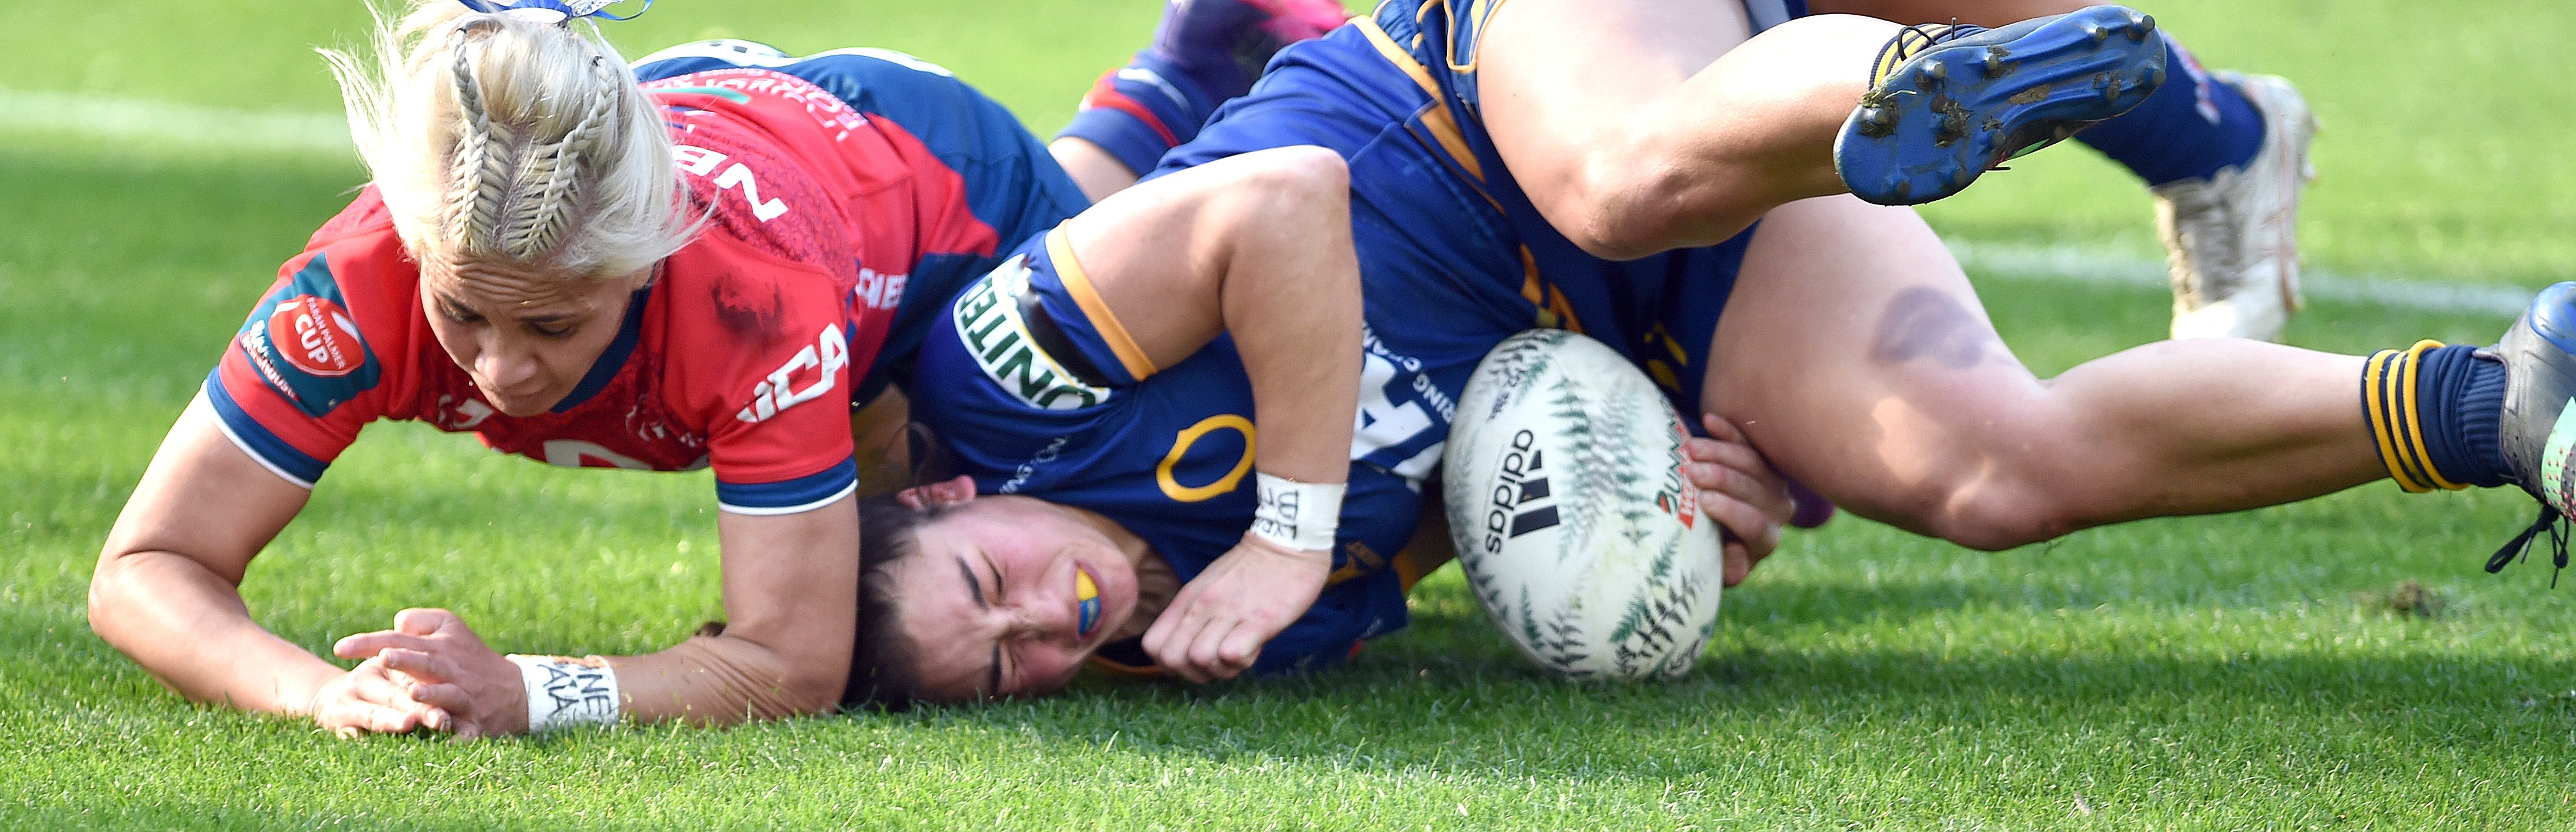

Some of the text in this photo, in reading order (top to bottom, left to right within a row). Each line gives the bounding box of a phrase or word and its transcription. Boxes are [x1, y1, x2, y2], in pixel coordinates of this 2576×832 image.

[671, 144, 789, 223] NB
[295, 313, 330, 364] CUP
[307, 297, 347, 371] FARAH PALMER
[961, 278, 1096, 410] UNITED
[1413, 372, 1457, 424] RING
[1485, 428, 1535, 554] adidas
